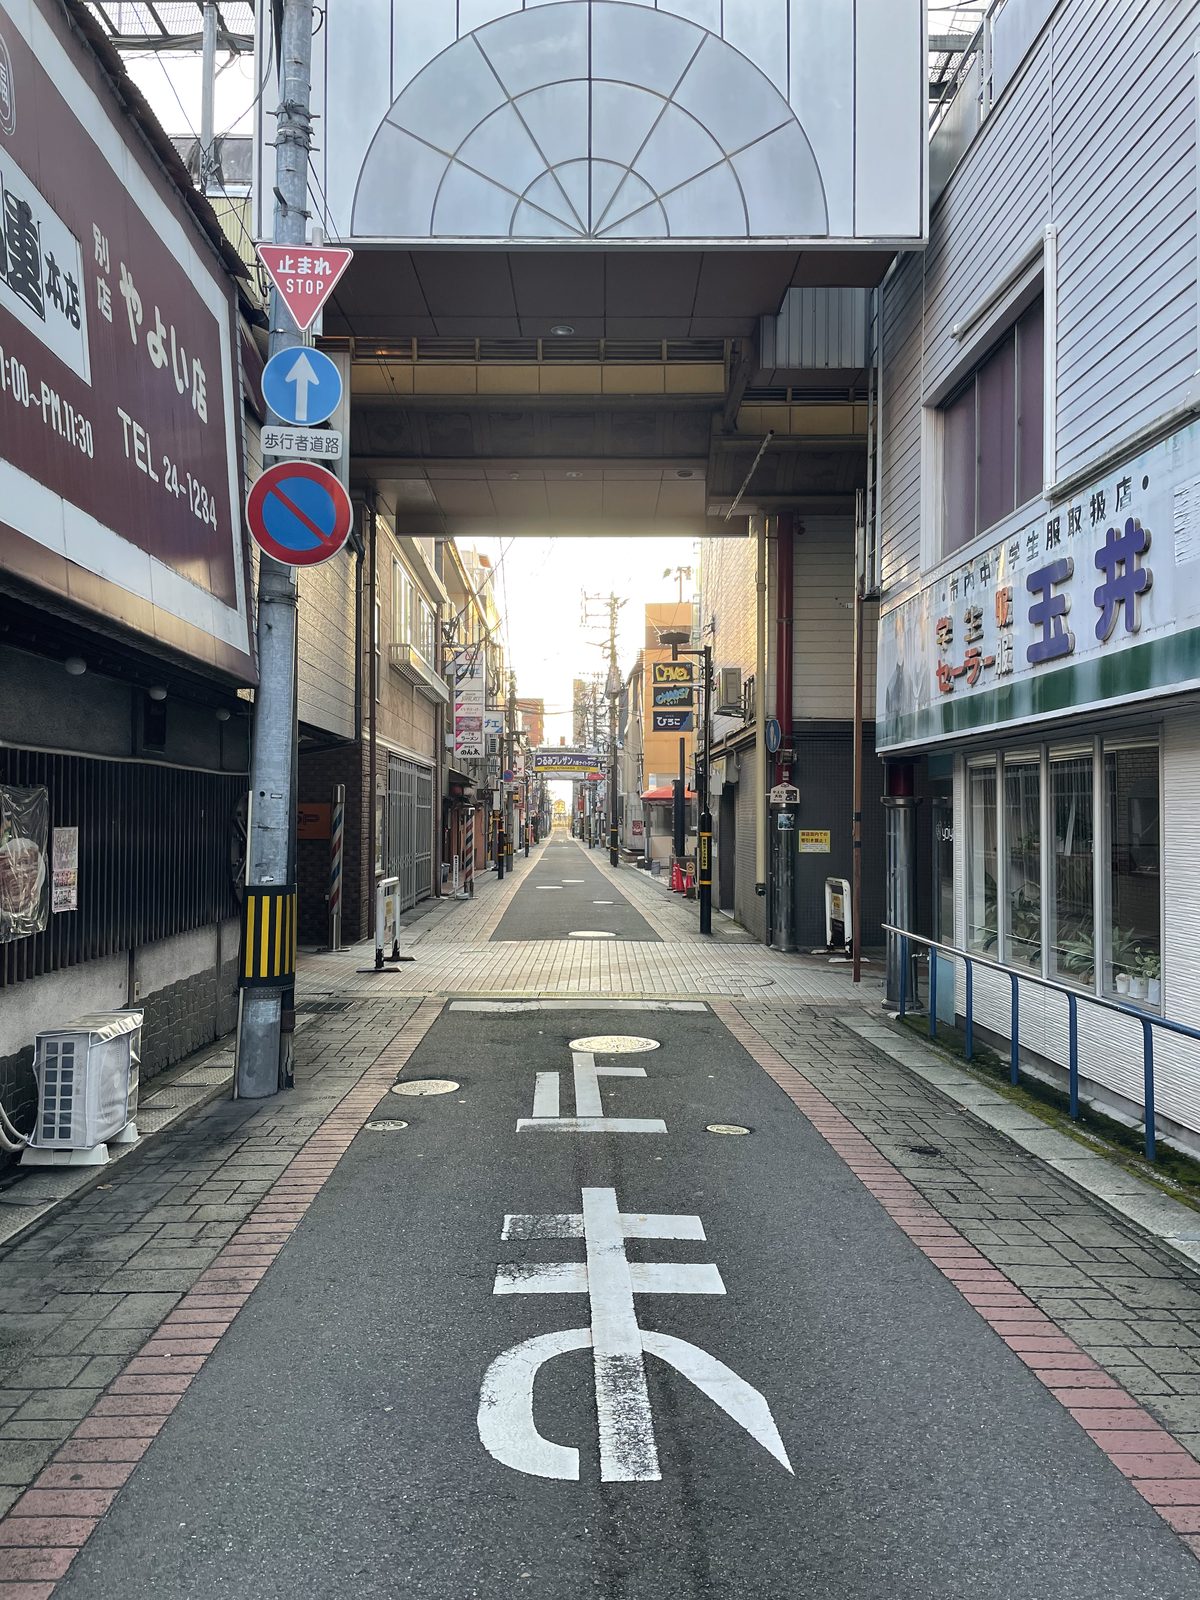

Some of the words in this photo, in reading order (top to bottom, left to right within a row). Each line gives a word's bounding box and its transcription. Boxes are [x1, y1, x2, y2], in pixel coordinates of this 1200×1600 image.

[44, 250, 81, 331] 本店
[276, 254, 332, 276] 止まれ
[286, 278, 324, 295] STOP
[119, 261, 208, 424] やよい店
[264, 432, 340, 454] 歩行者道路
[117, 406, 159, 483] TEL
[162, 454, 218, 532] 24-1234
[1026, 517, 1154, 664] 玉井
[656, 716, 681, 727] ひろこ
